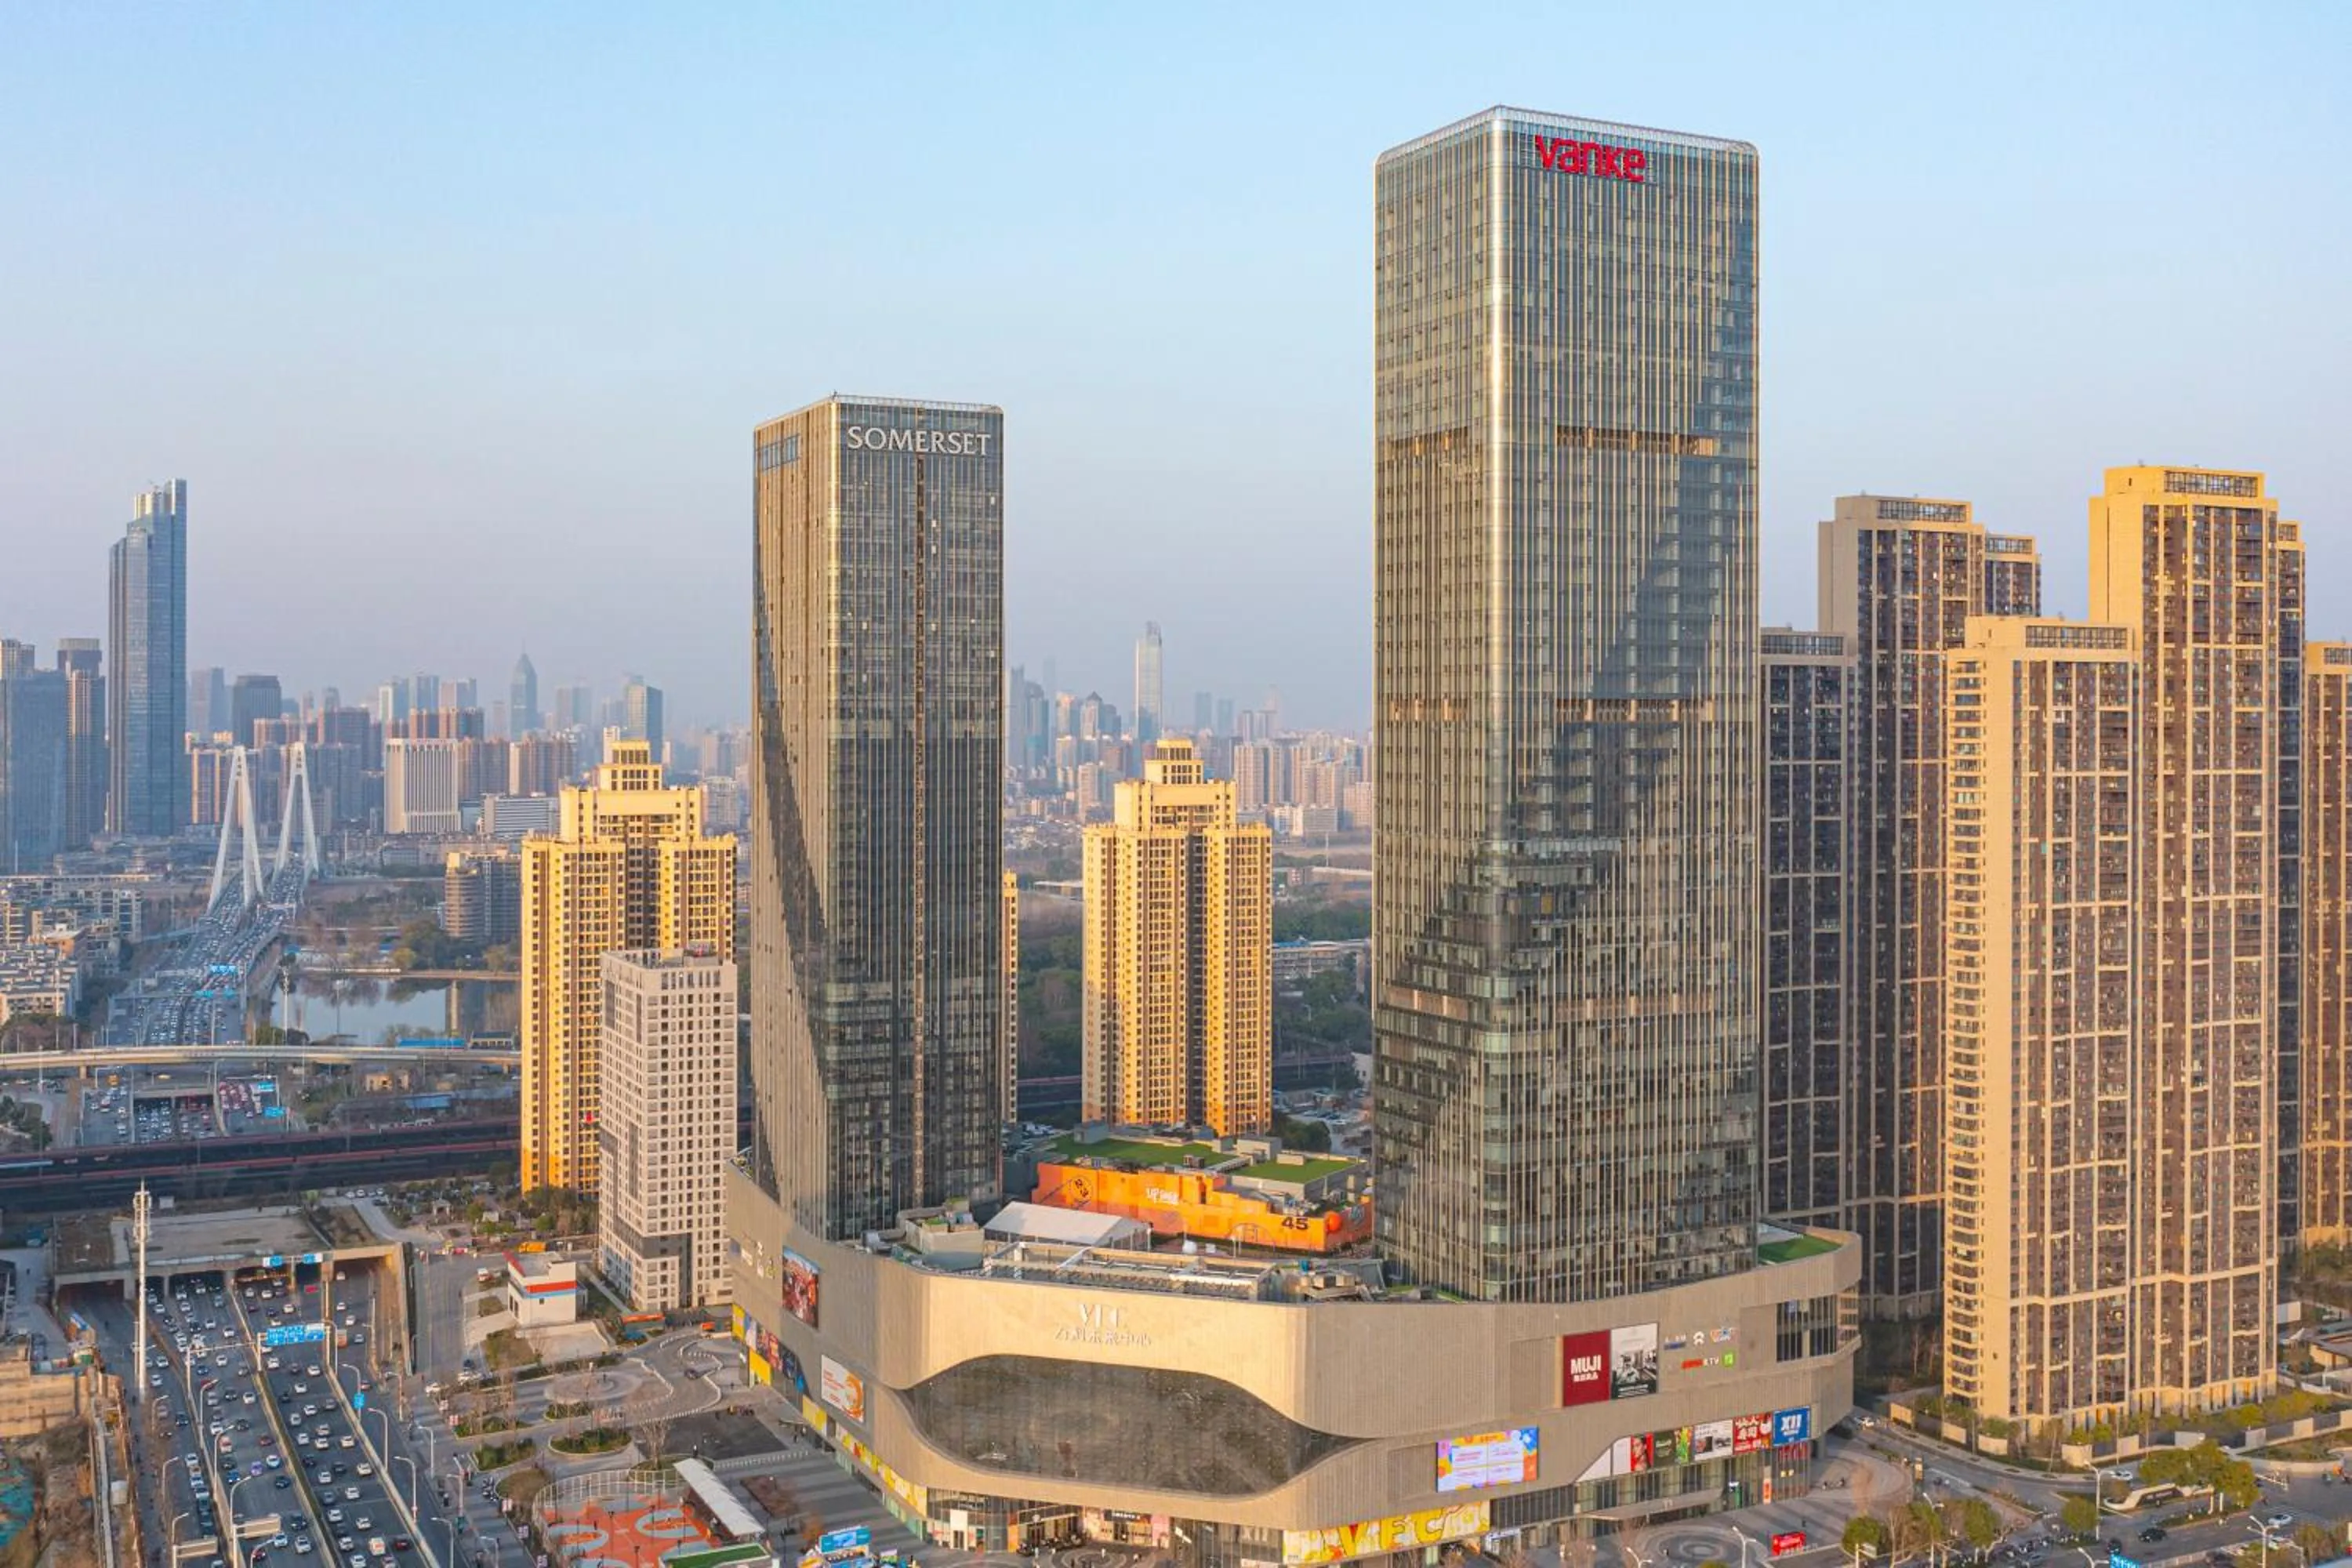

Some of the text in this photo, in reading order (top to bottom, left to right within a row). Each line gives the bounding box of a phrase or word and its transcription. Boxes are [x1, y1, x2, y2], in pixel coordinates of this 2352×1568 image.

[847, 426, 992, 456] SOMERSET
[1281, 1216, 1308, 1230] 45
[1570, 1355, 1602, 1374] MUJI
